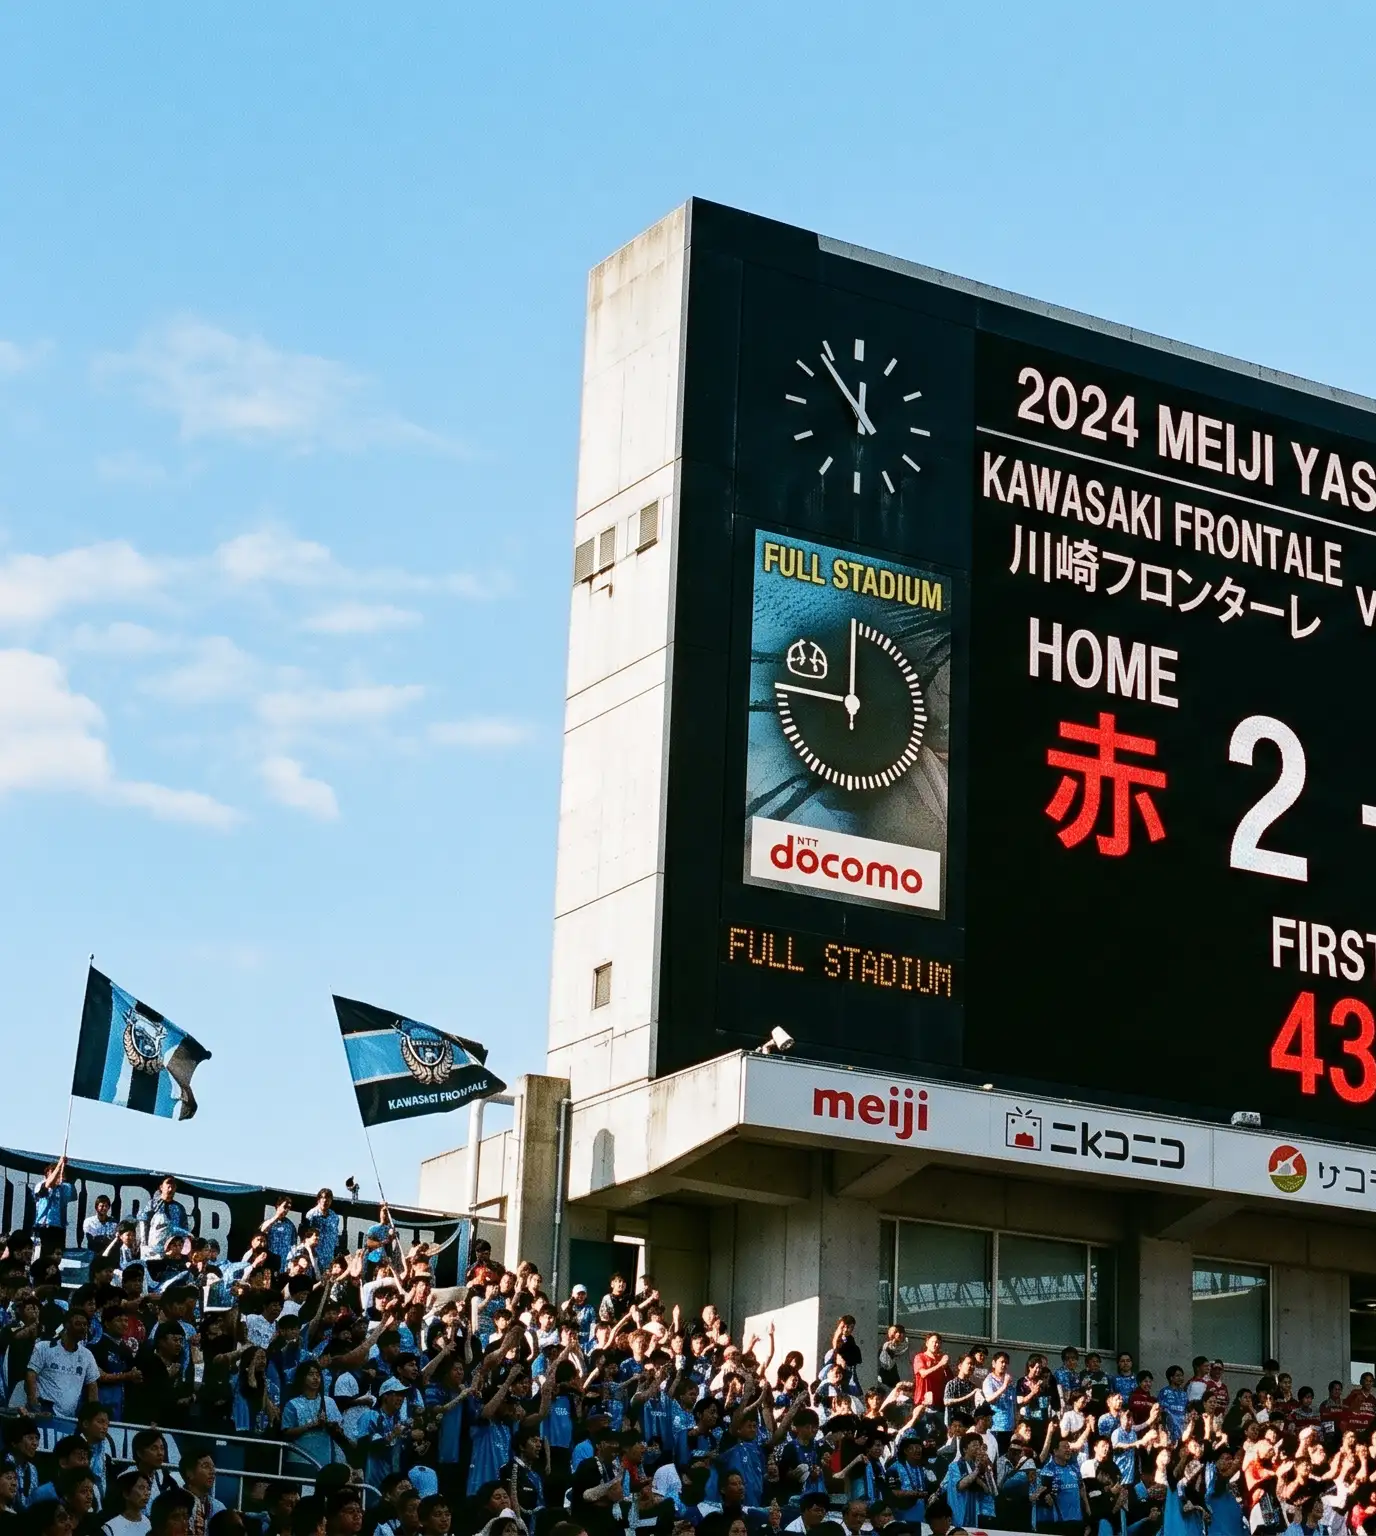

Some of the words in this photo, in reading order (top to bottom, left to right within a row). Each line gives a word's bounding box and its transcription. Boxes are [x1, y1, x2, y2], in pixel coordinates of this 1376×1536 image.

[1017, 368, 1138, 447] 2024
[1158, 405, 1273, 486] MEIJI
[984, 451, 1163, 541] KAWASAKI
[1175, 505, 1344, 587] FRONTALE
[763, 541, 826, 586] FULL
[833, 558, 943, 611] STADIUM
[1010, 524, 1322, 640] 川崎フロンターレ
[1030, 617, 1178, 708] HOME
[1045, 712, 1166, 856] 赤
[1229, 715, 1307, 881] 2
[769, 833, 924, 895] docomo
[796, 835, 819, 849] NTT
[730, 928, 803, 971] FULL
[825, 944, 950, 996] STADIUM
[813, 1085, 928, 1140] meiji
